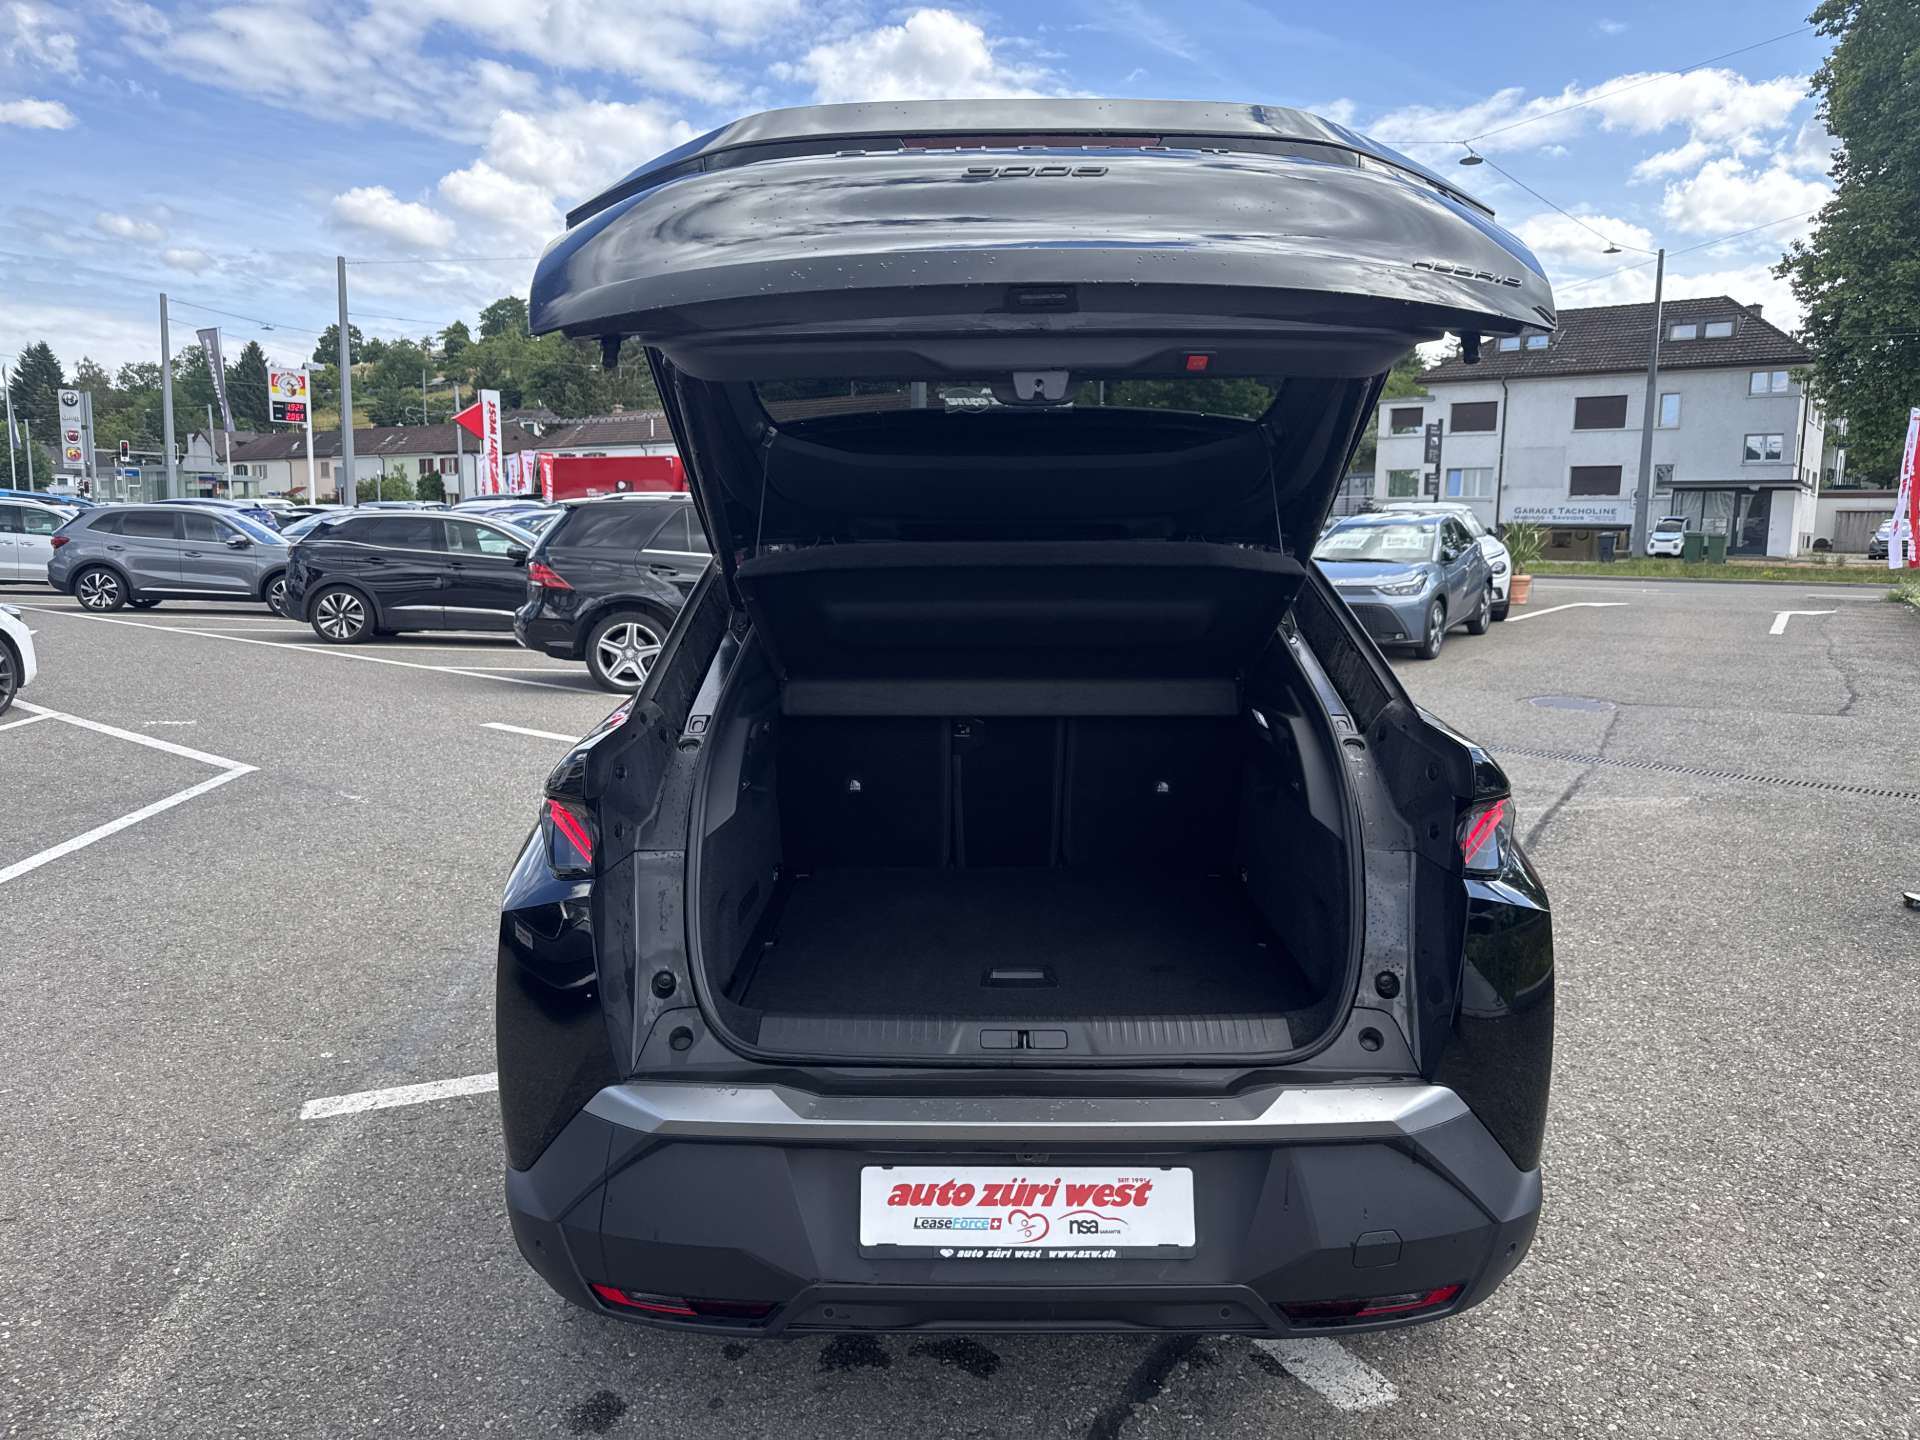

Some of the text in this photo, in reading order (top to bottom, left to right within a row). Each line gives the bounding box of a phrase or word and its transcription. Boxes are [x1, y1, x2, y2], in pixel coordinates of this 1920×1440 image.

[1514, 506, 1617, 515] GARAGE TACHOLINE
[887, 1177, 1153, 1208] auto züri west
[913, 1217, 989, 1230] LeaseForce
[1069, 1219, 1099, 1234] nsa
[957, 1247, 1117, 1258] auto züri west www.azw.ch
